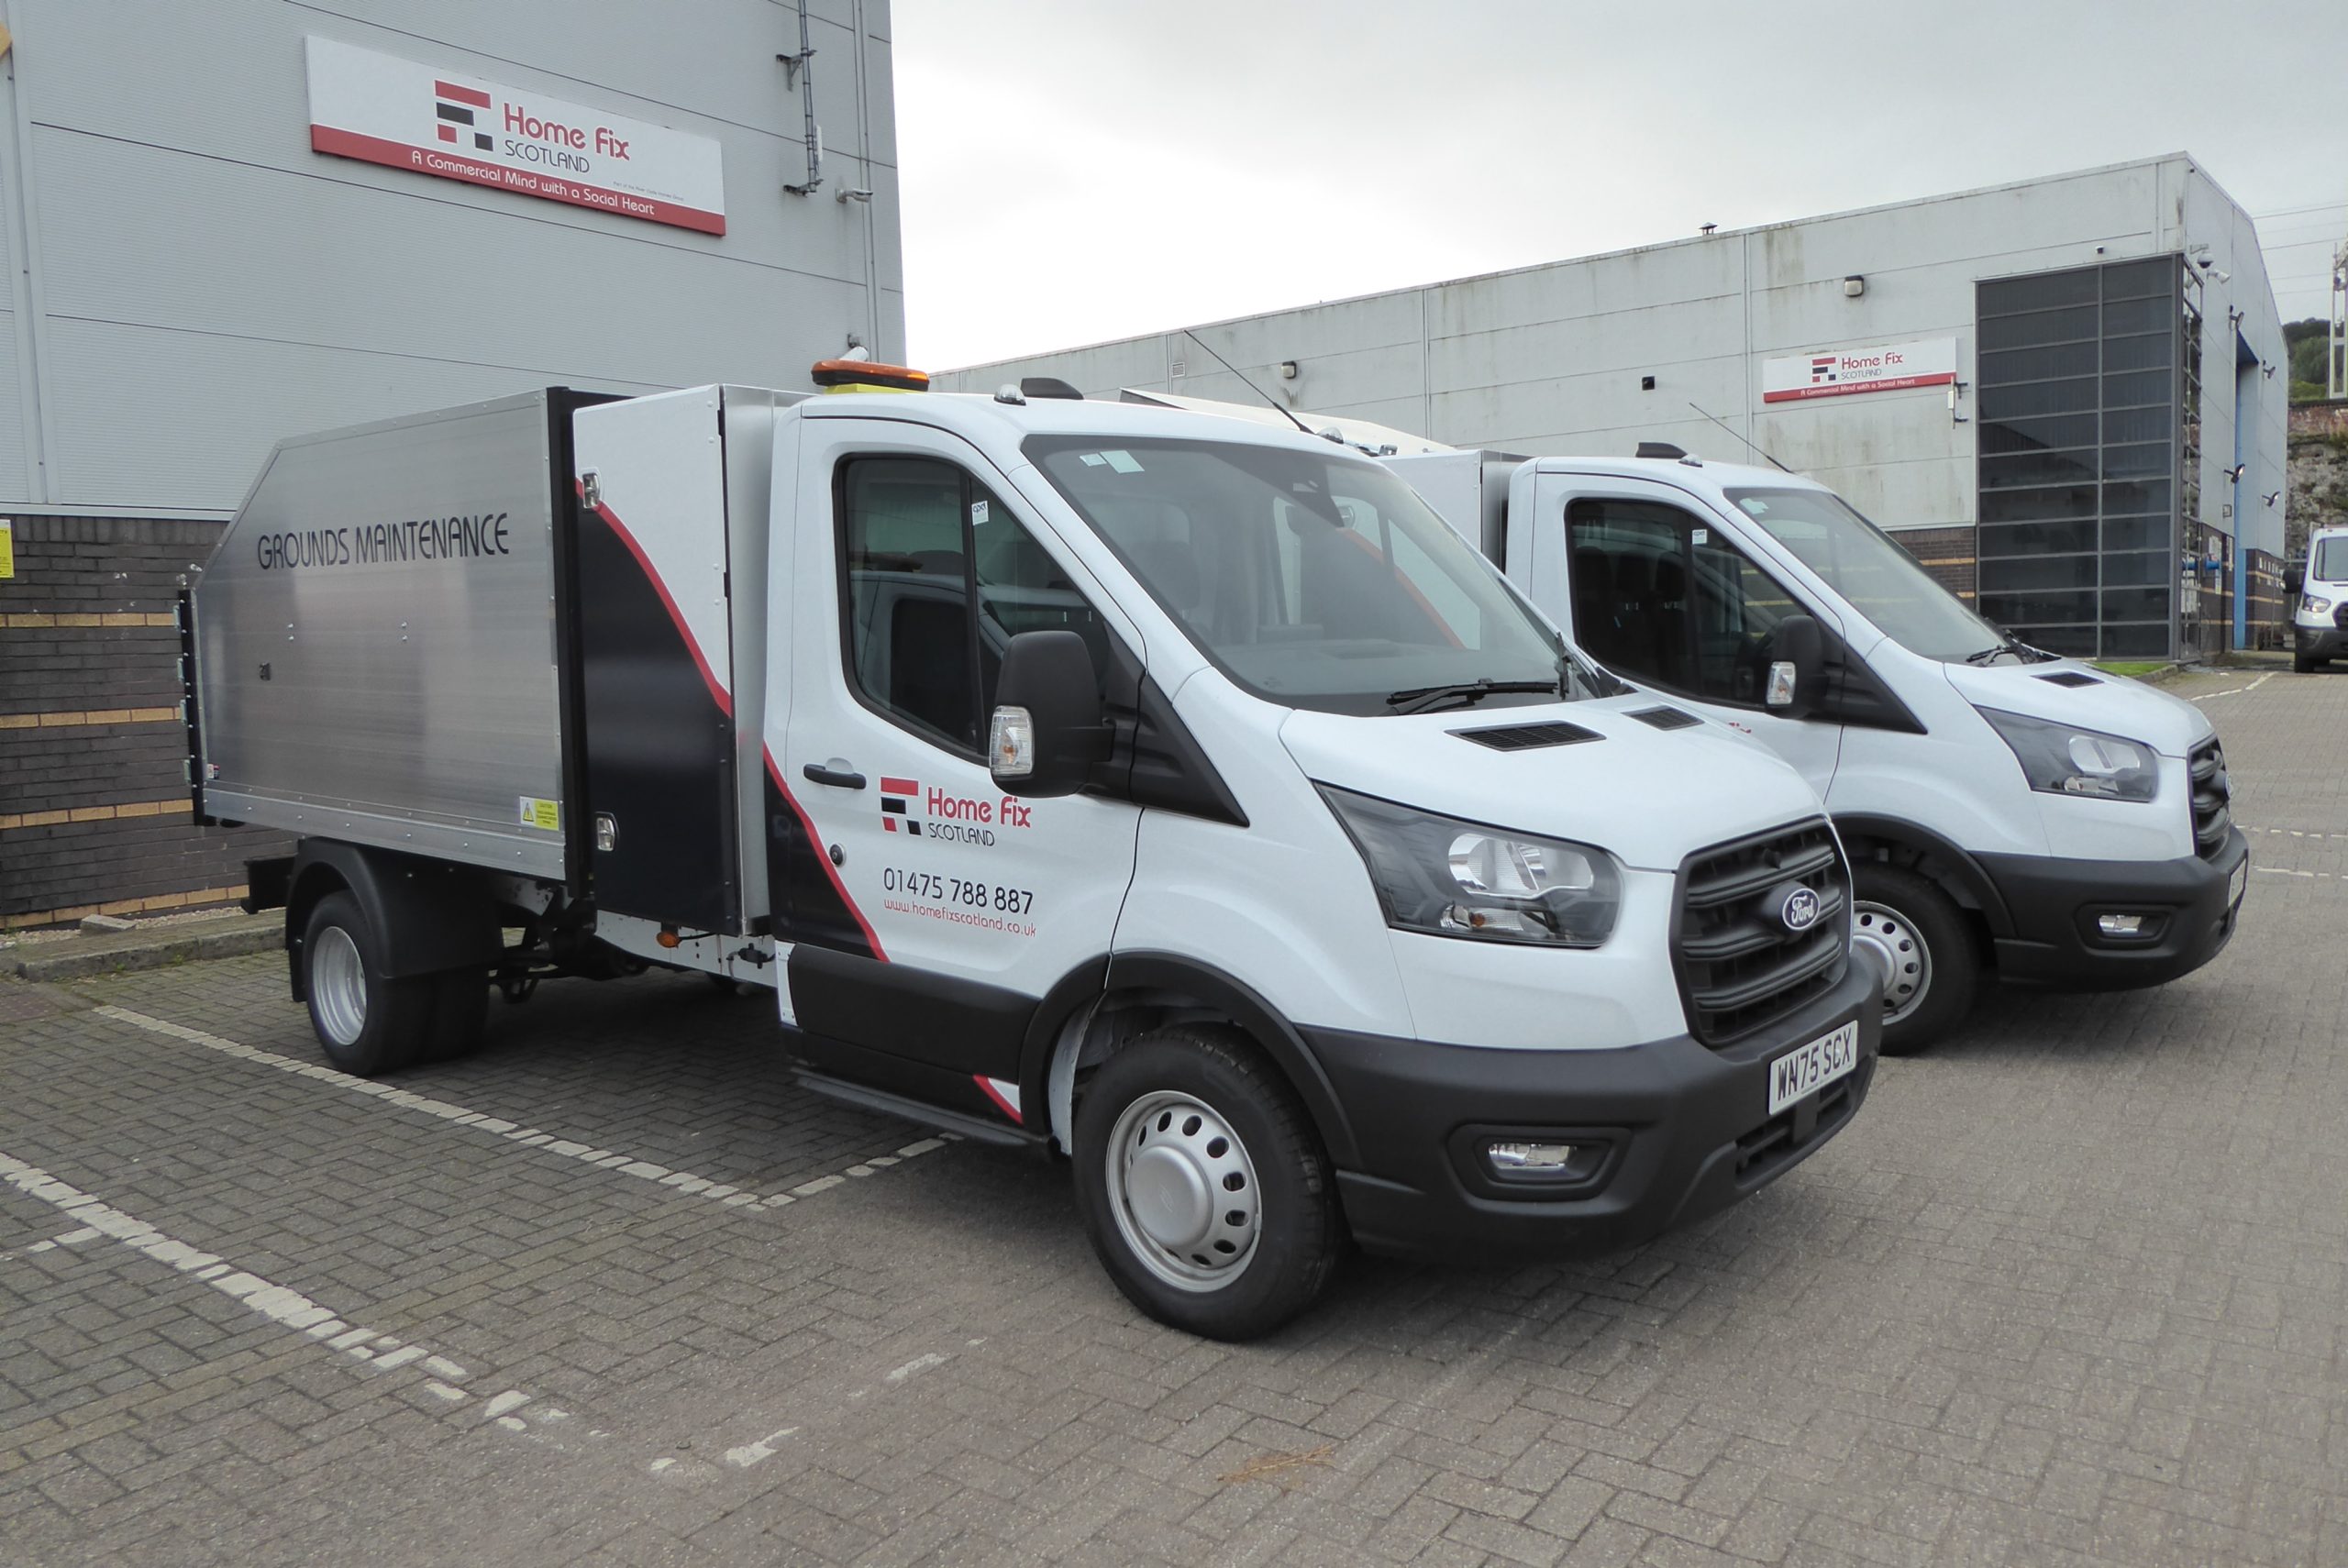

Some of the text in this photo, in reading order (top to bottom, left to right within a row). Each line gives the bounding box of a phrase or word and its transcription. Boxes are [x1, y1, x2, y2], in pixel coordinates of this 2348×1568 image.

[504, 102, 630, 161] Home Fix
[504, 139, 590, 173] SCOTLAND
[412, 150, 422, 164] A
[426, 154, 501, 182] Commercial
[504, 171, 537, 190] Mind
[541, 181, 567, 196] with
[571, 189, 580, 198] a
[583, 188, 618, 207] Social
[622, 196, 655, 215] Heart
[1841, 368, 1882, 381] SCOTLAND
[1842, 351, 1903, 370] Home Fix
[258, 512, 510, 570] GROUNDS MAINTENANCE
[927, 786, 1032, 829] Home Fix
[927, 822, 995, 847] SCOTLAND
[883, 867, 1034, 915] 01475 788 887
[1790, 894, 1815, 924] Ford
[883, 898, 1036, 938] www.homefixscotland.co.uk
[1778, 1027, 1852, 1101] WN75 SCX
